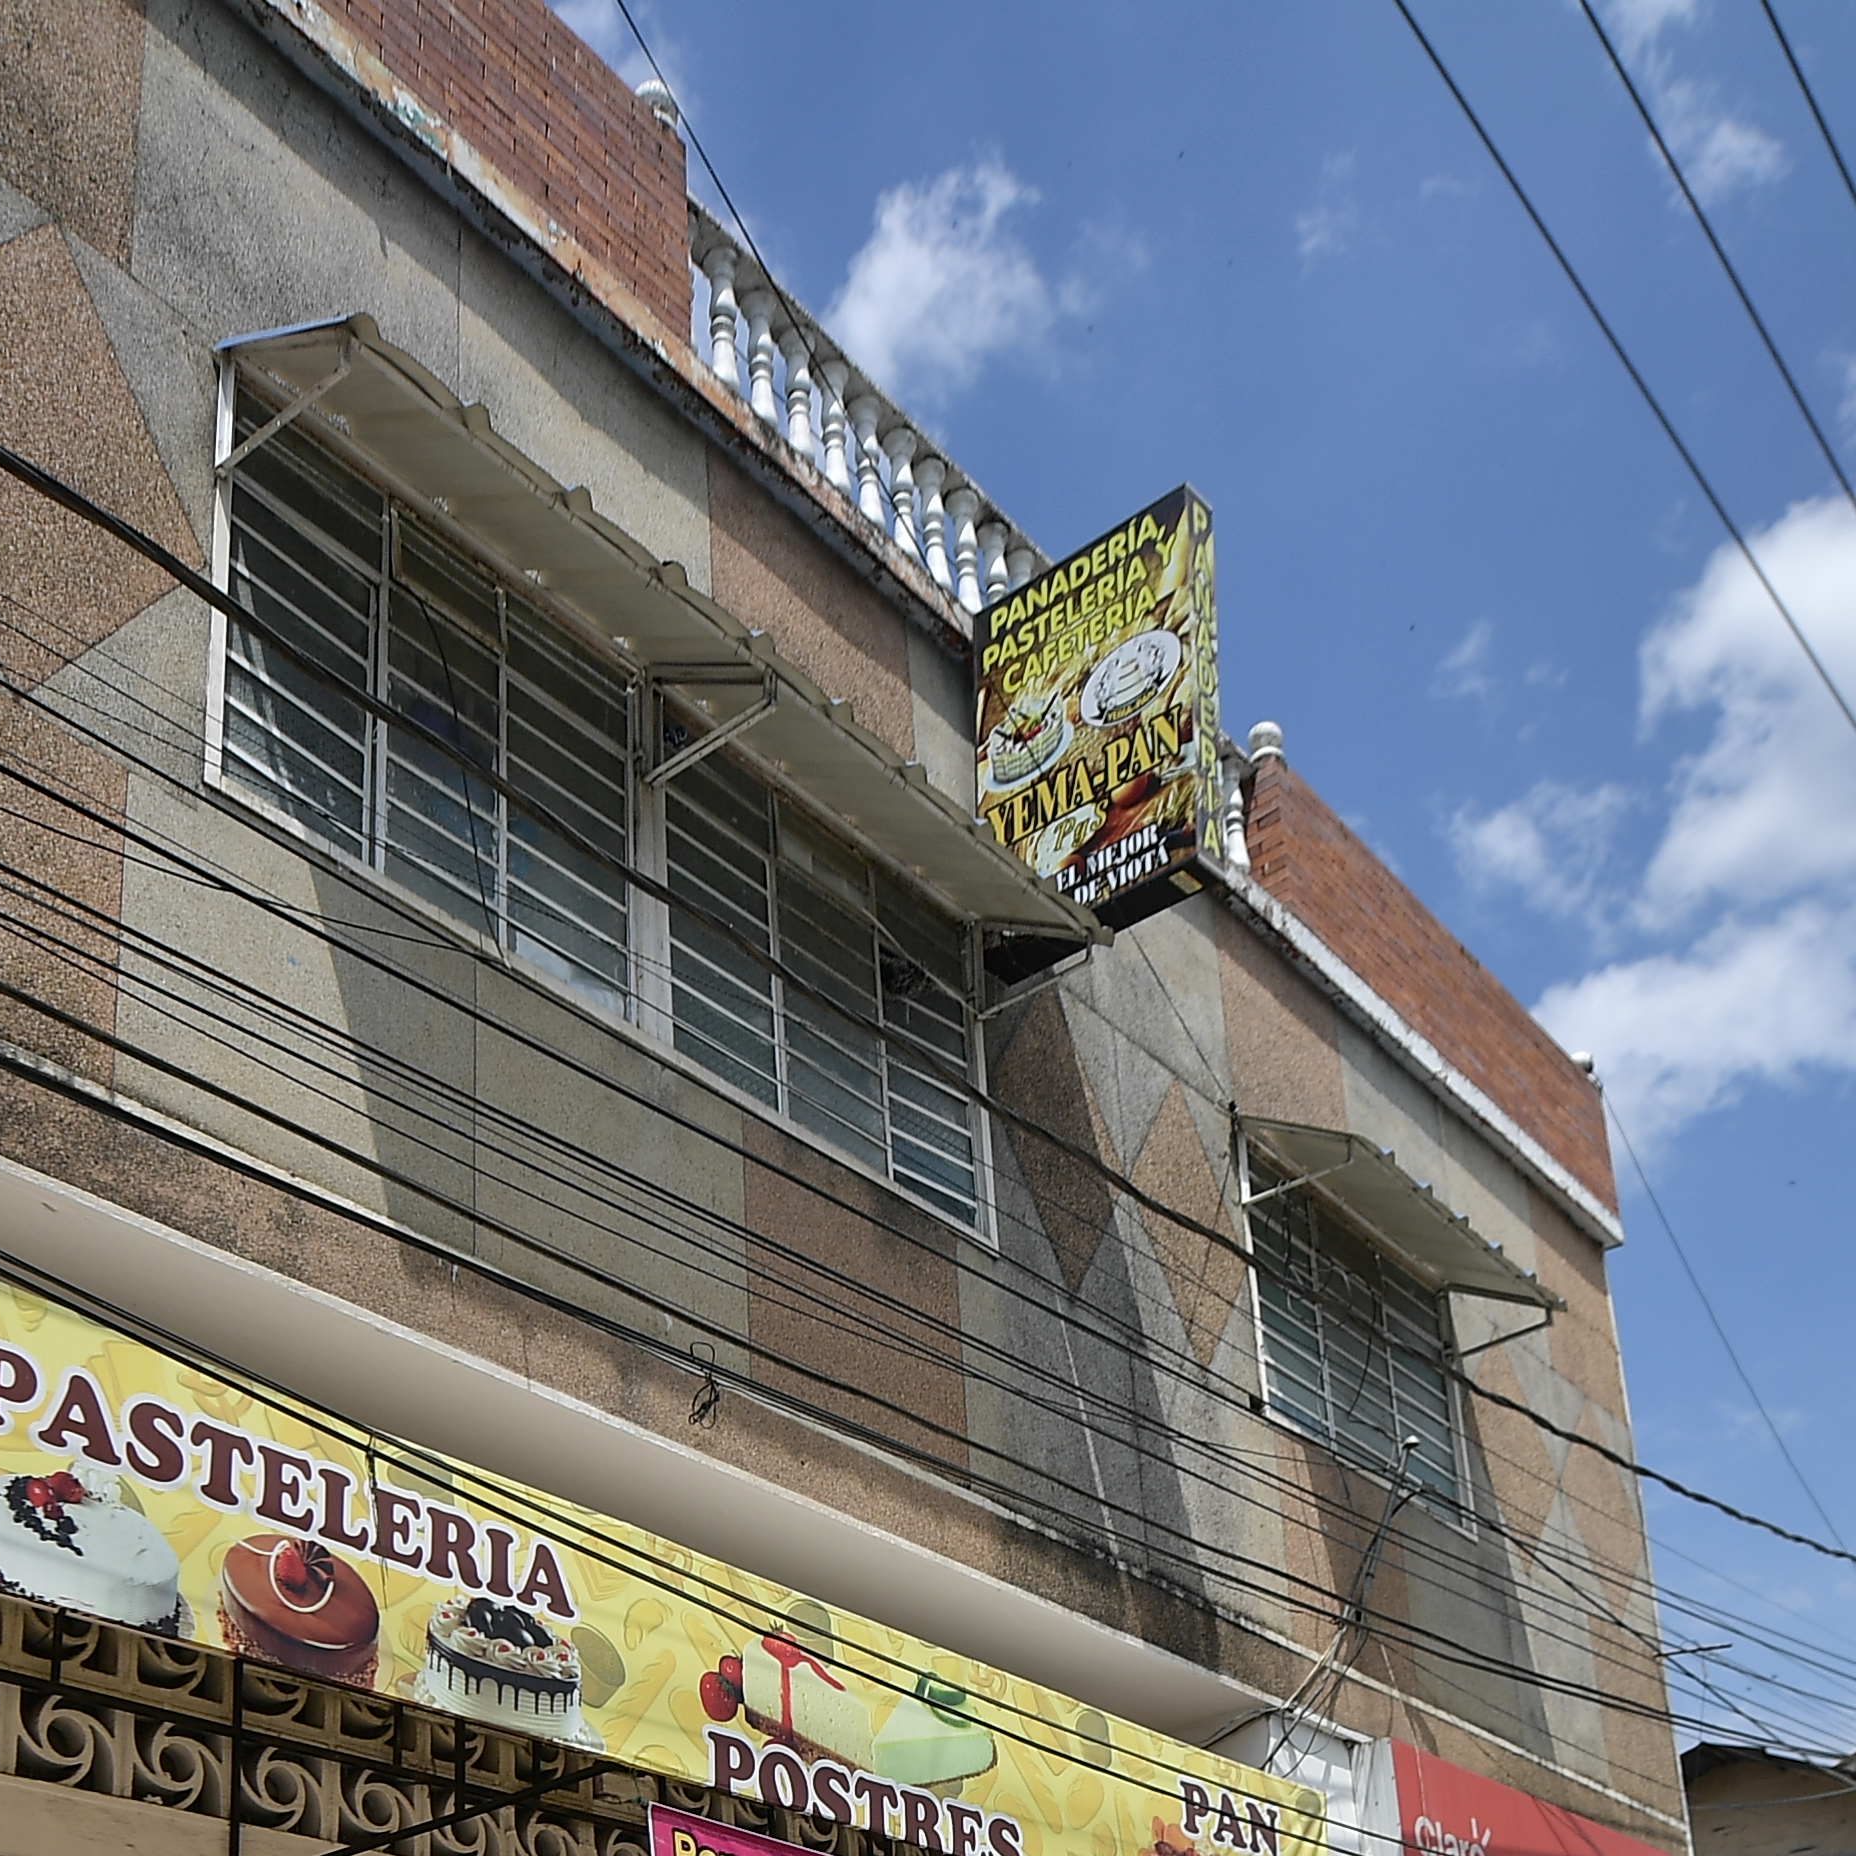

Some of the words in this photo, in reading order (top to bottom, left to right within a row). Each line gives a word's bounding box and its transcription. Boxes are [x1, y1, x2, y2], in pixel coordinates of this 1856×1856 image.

[982, 555, 1147, 676] PASTELERÍA
[1155, 532, 1176, 567] Y
[990, 513, 1167, 640] PANADERÍA,
[1002, 585, 1157, 694] CAFETERÍA
[985, 703, 1183, 848] YEMA-PAN
[1055, 864, 1082, 893] EL
[1086, 823, 1160, 879] MEJOR
[1073, 876, 1102, 906] DE
[1106, 836, 1171, 891] VIOTÁ
